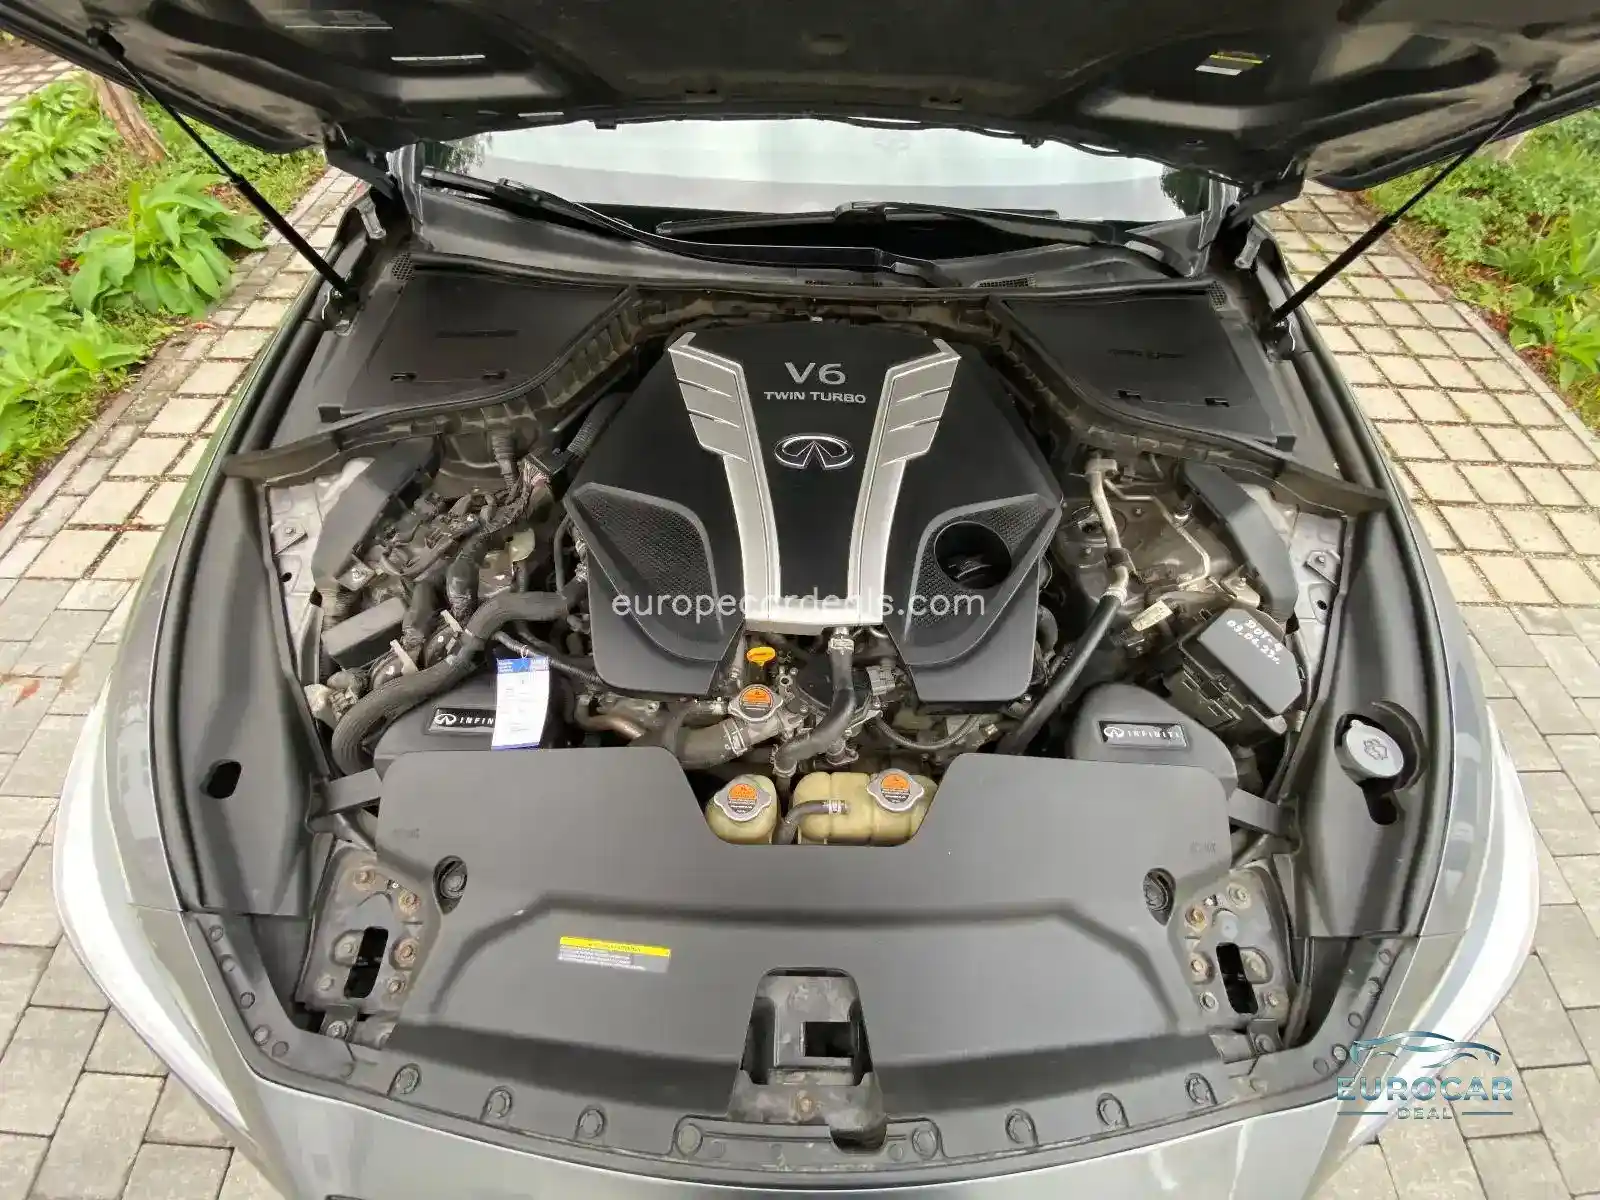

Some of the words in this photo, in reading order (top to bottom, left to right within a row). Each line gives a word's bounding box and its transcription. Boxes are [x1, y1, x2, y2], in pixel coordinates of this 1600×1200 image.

[784, 361, 846, 385] V6
[763, 391, 806, 401] TWIN
[809, 391, 867, 404] TURBO
[459, 717, 495, 726] INFIN
